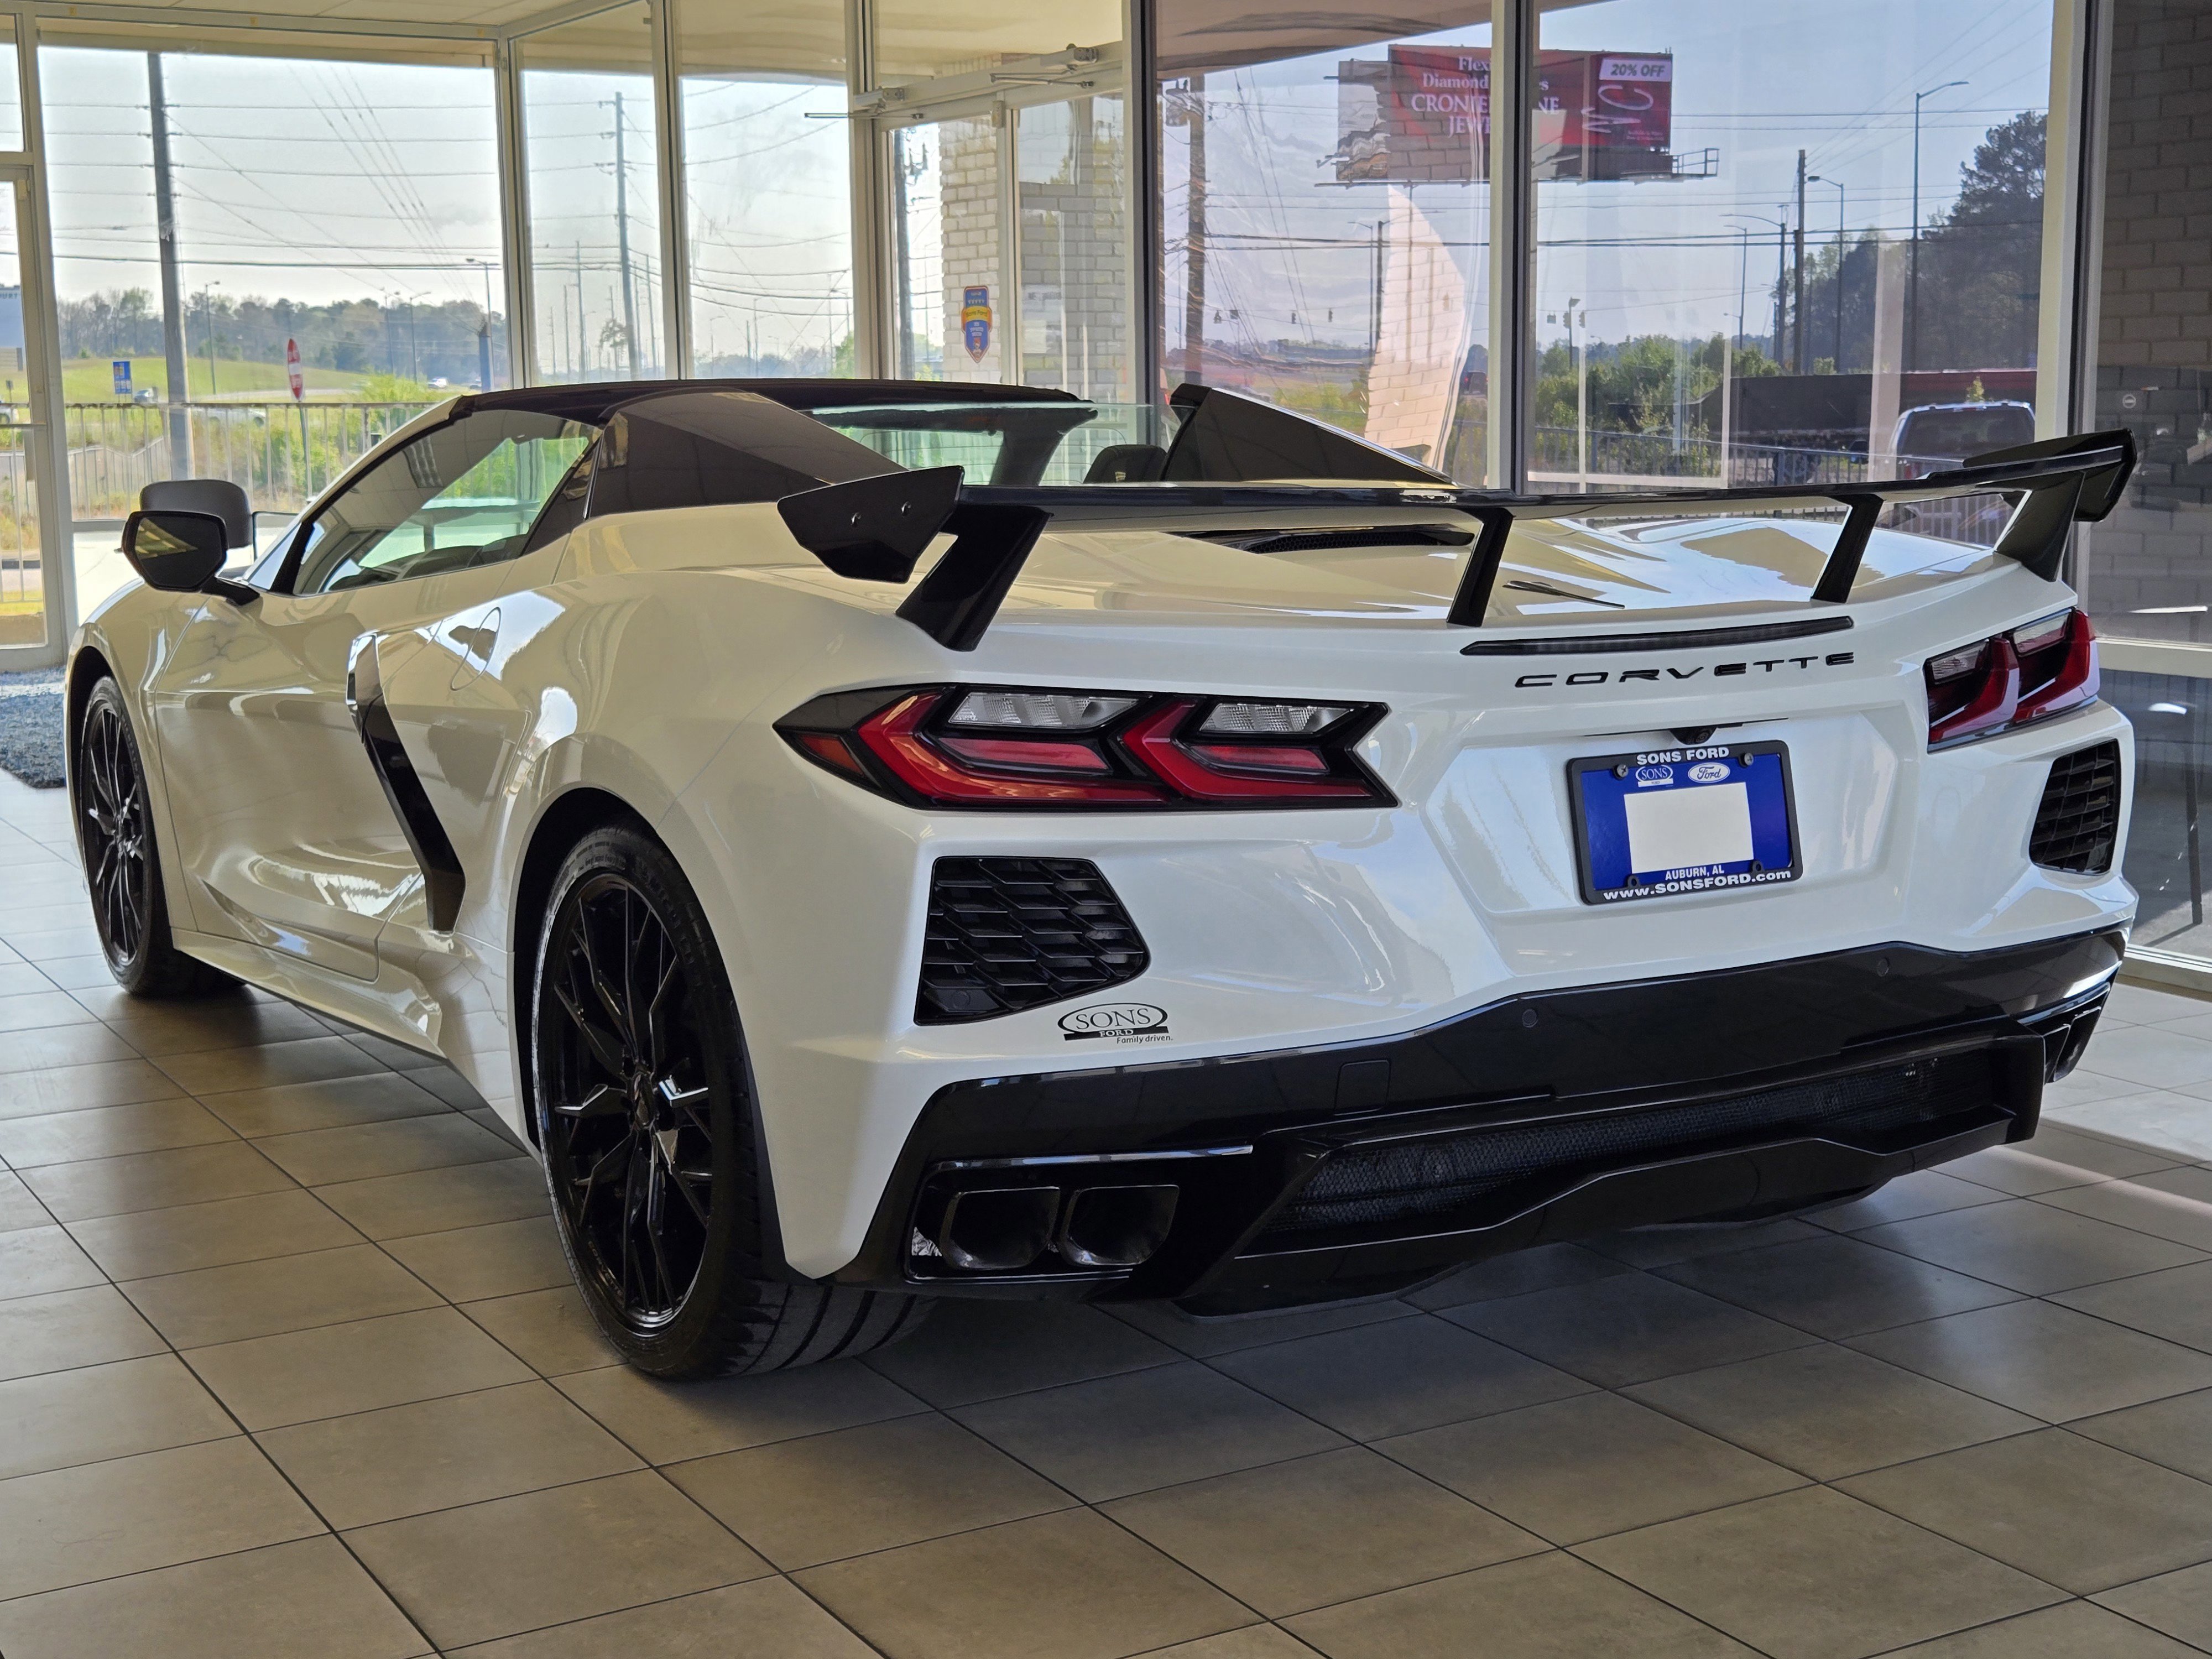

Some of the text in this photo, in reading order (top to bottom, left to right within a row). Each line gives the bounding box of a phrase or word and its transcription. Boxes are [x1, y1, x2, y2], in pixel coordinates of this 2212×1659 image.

[1459, 56, 1491, 71] Flex
[1611, 64, 1665, 77] 20% OFF
[1423, 72, 1489, 89] Diamond
[1411, 93, 1491, 113] CRONIE
[1515, 651, 1855, 688] CORVETTE
[1636, 747, 1730, 766] SONS FORD
[1641, 767, 1668, 780] SONS
[1697, 766, 1722, 780] Ford
[1665, 865, 1725, 880] AUBURN, AL
[1603, 870, 1792, 900] www.SONSFORD.com
[1076, 1008, 1151, 1030] SONS
[1099, 1029, 1134, 1037] FORD
[1117, 1036, 1144, 1044] Family
